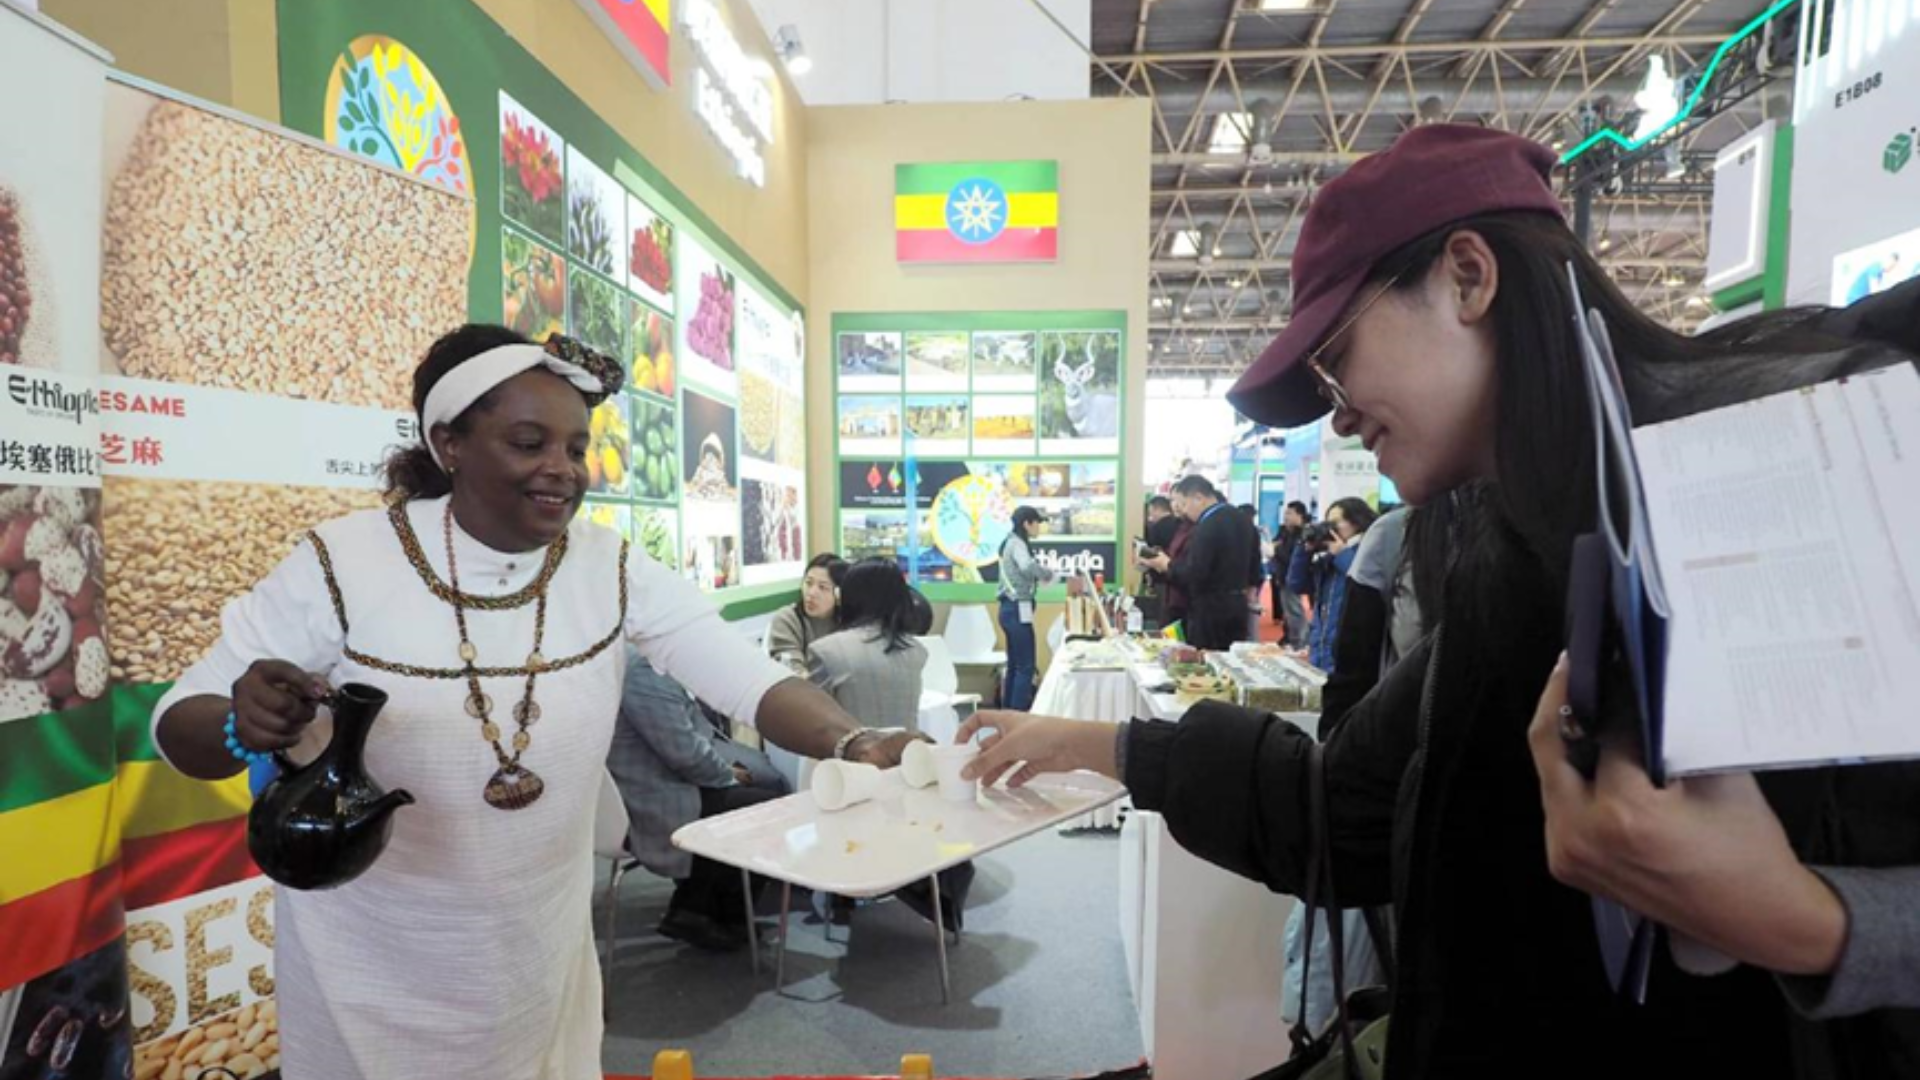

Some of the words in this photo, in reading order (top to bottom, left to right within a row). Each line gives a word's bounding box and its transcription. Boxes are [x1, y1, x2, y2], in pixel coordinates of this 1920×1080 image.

[0, 440, 98, 476] 埃塞俄比
[100, 433, 164, 466] 芝麻
